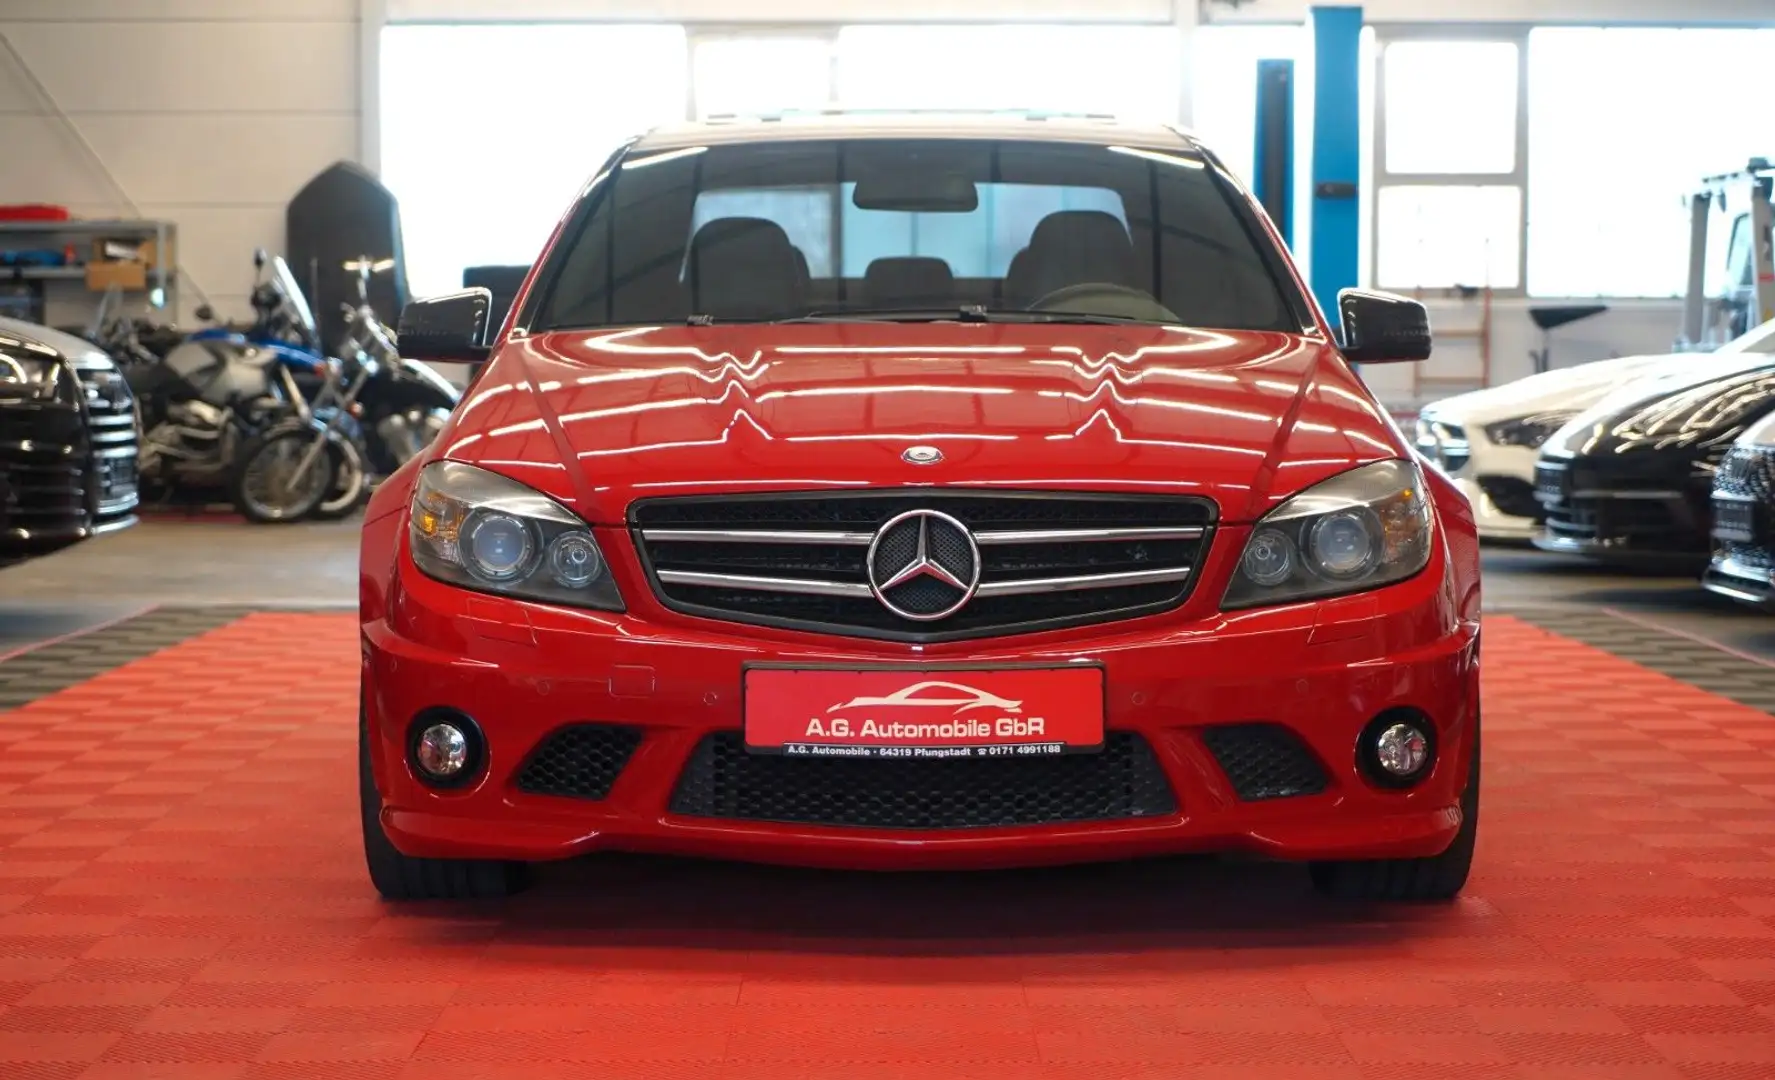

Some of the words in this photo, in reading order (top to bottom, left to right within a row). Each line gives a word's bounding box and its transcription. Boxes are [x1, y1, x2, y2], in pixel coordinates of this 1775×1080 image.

[806, 718, 855, 738] A.G.
[860, 719, 991, 738] Automobile
[995, 717, 1045, 737] GbR
[788, 745, 809, 754] A.G.
[812, 746, 870, 756] Automobile
[880, 748, 911, 757] 64319
[915, 748, 971, 758] Pfungstadt
[989, 746, 1013, 755] 0171
[1017, 744, 1061, 754] 4991188
